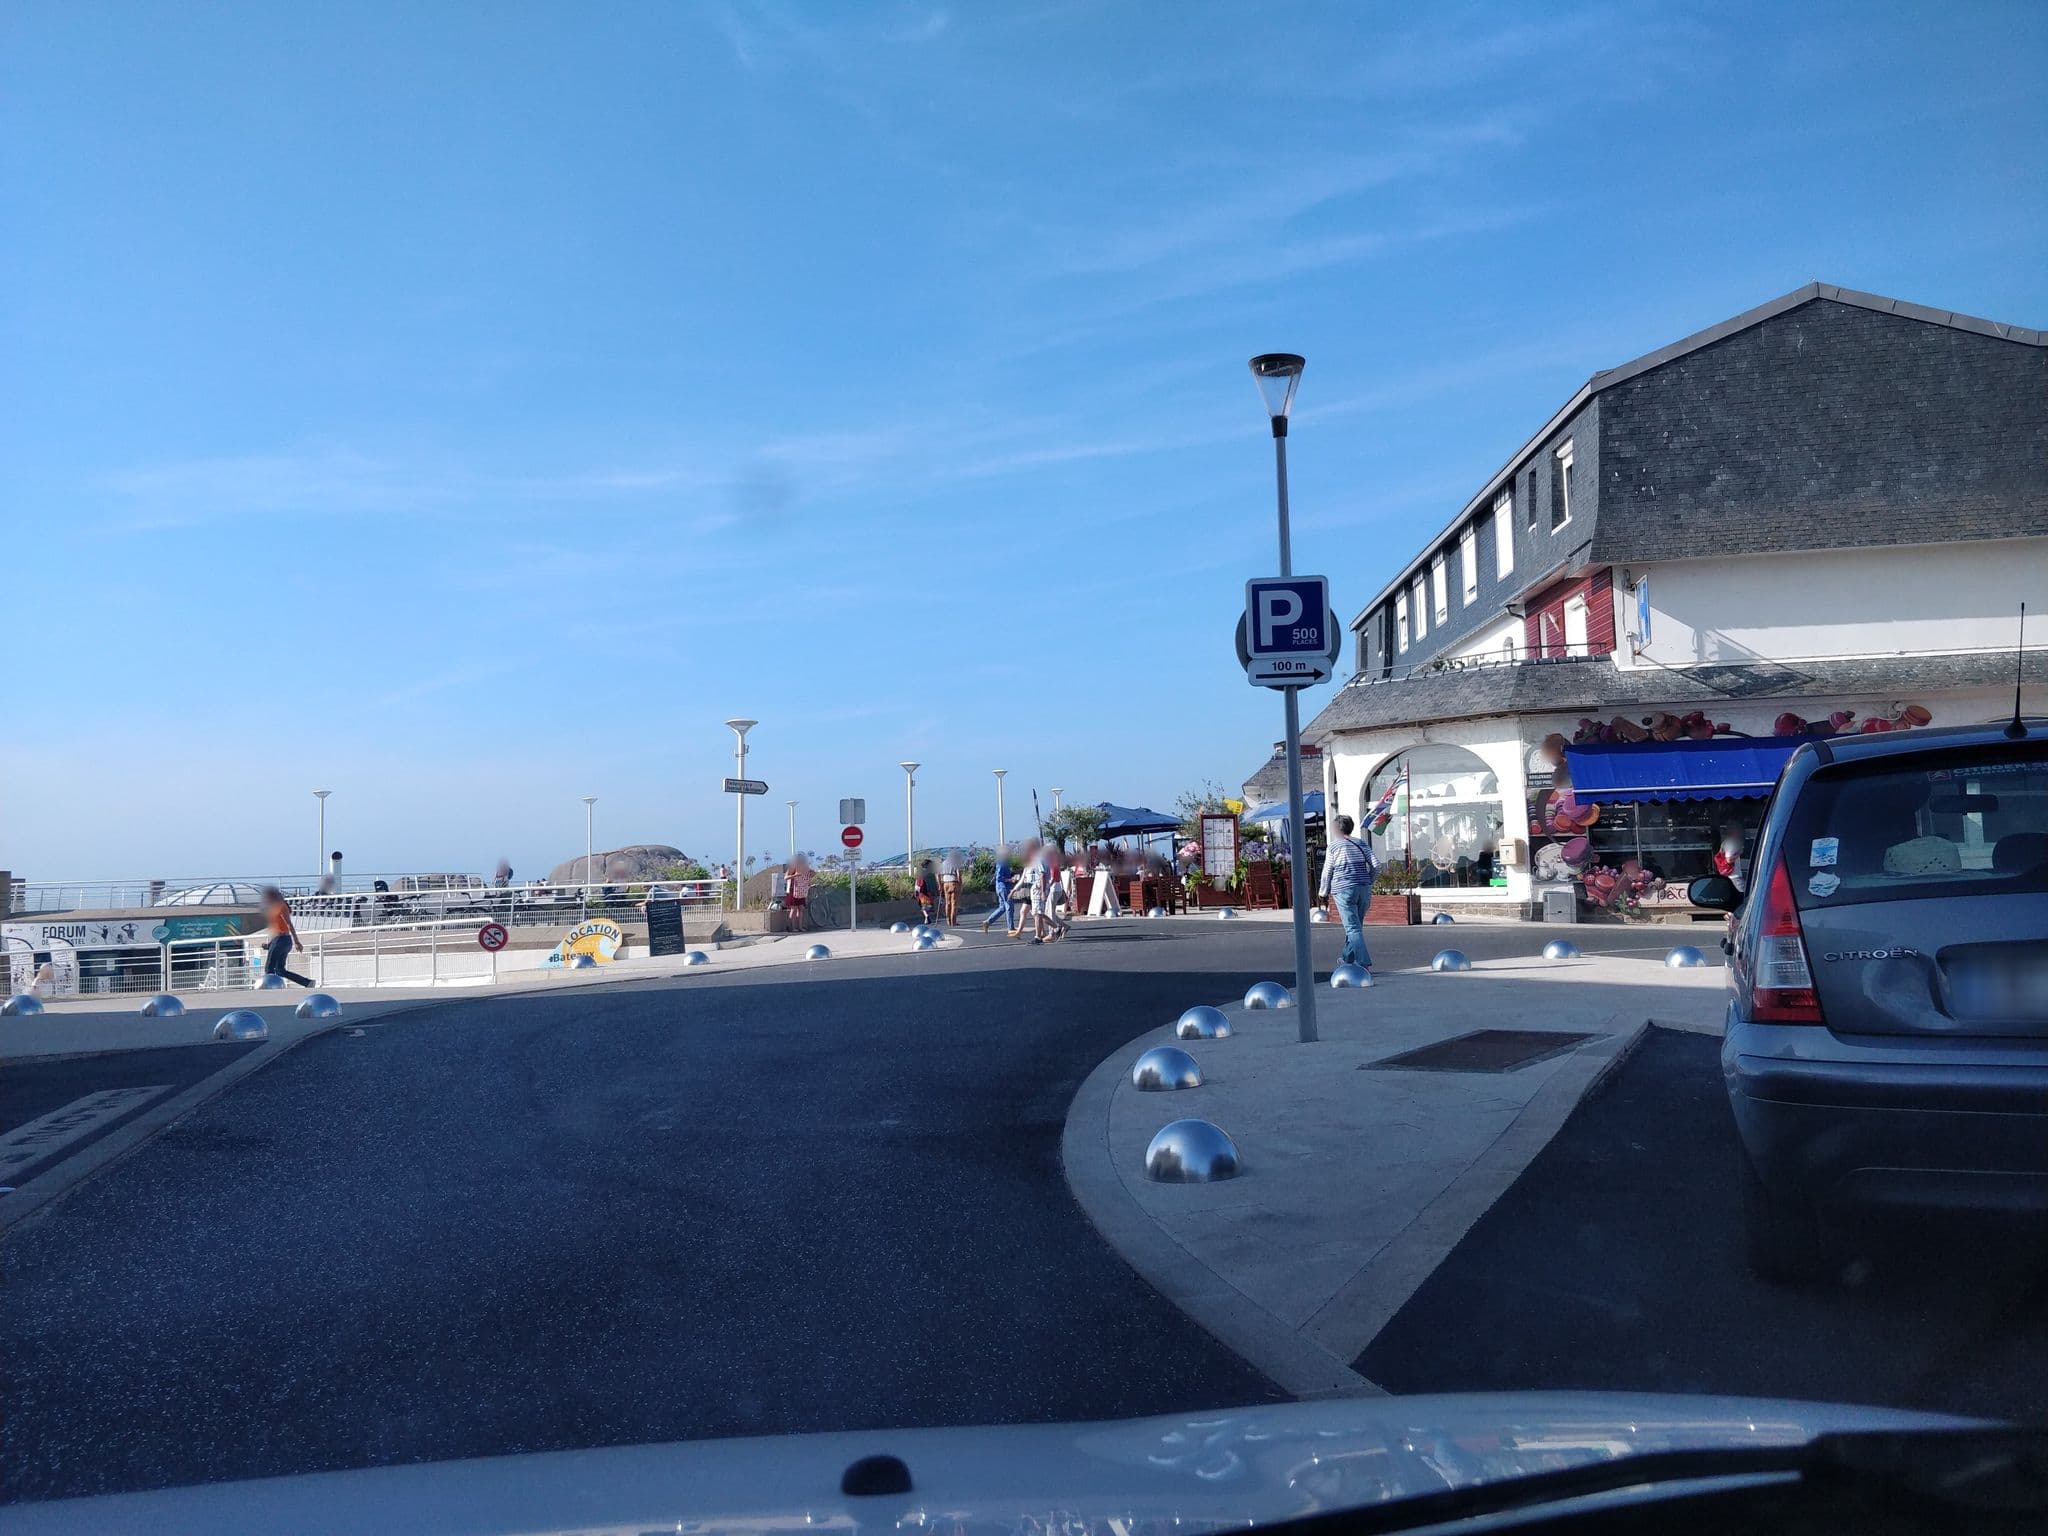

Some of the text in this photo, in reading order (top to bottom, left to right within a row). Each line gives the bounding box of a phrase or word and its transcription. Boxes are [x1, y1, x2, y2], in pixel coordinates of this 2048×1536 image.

[1258, 589, 1304, 647] P
[1292, 627, 1318, 640] 500
[1272, 662, 1306, 671] 100 m
[42, 925, 86, 939] FORUM
[565, 924, 620, 945] LOCATION
[1823, 947, 1919, 962] CITROËN
